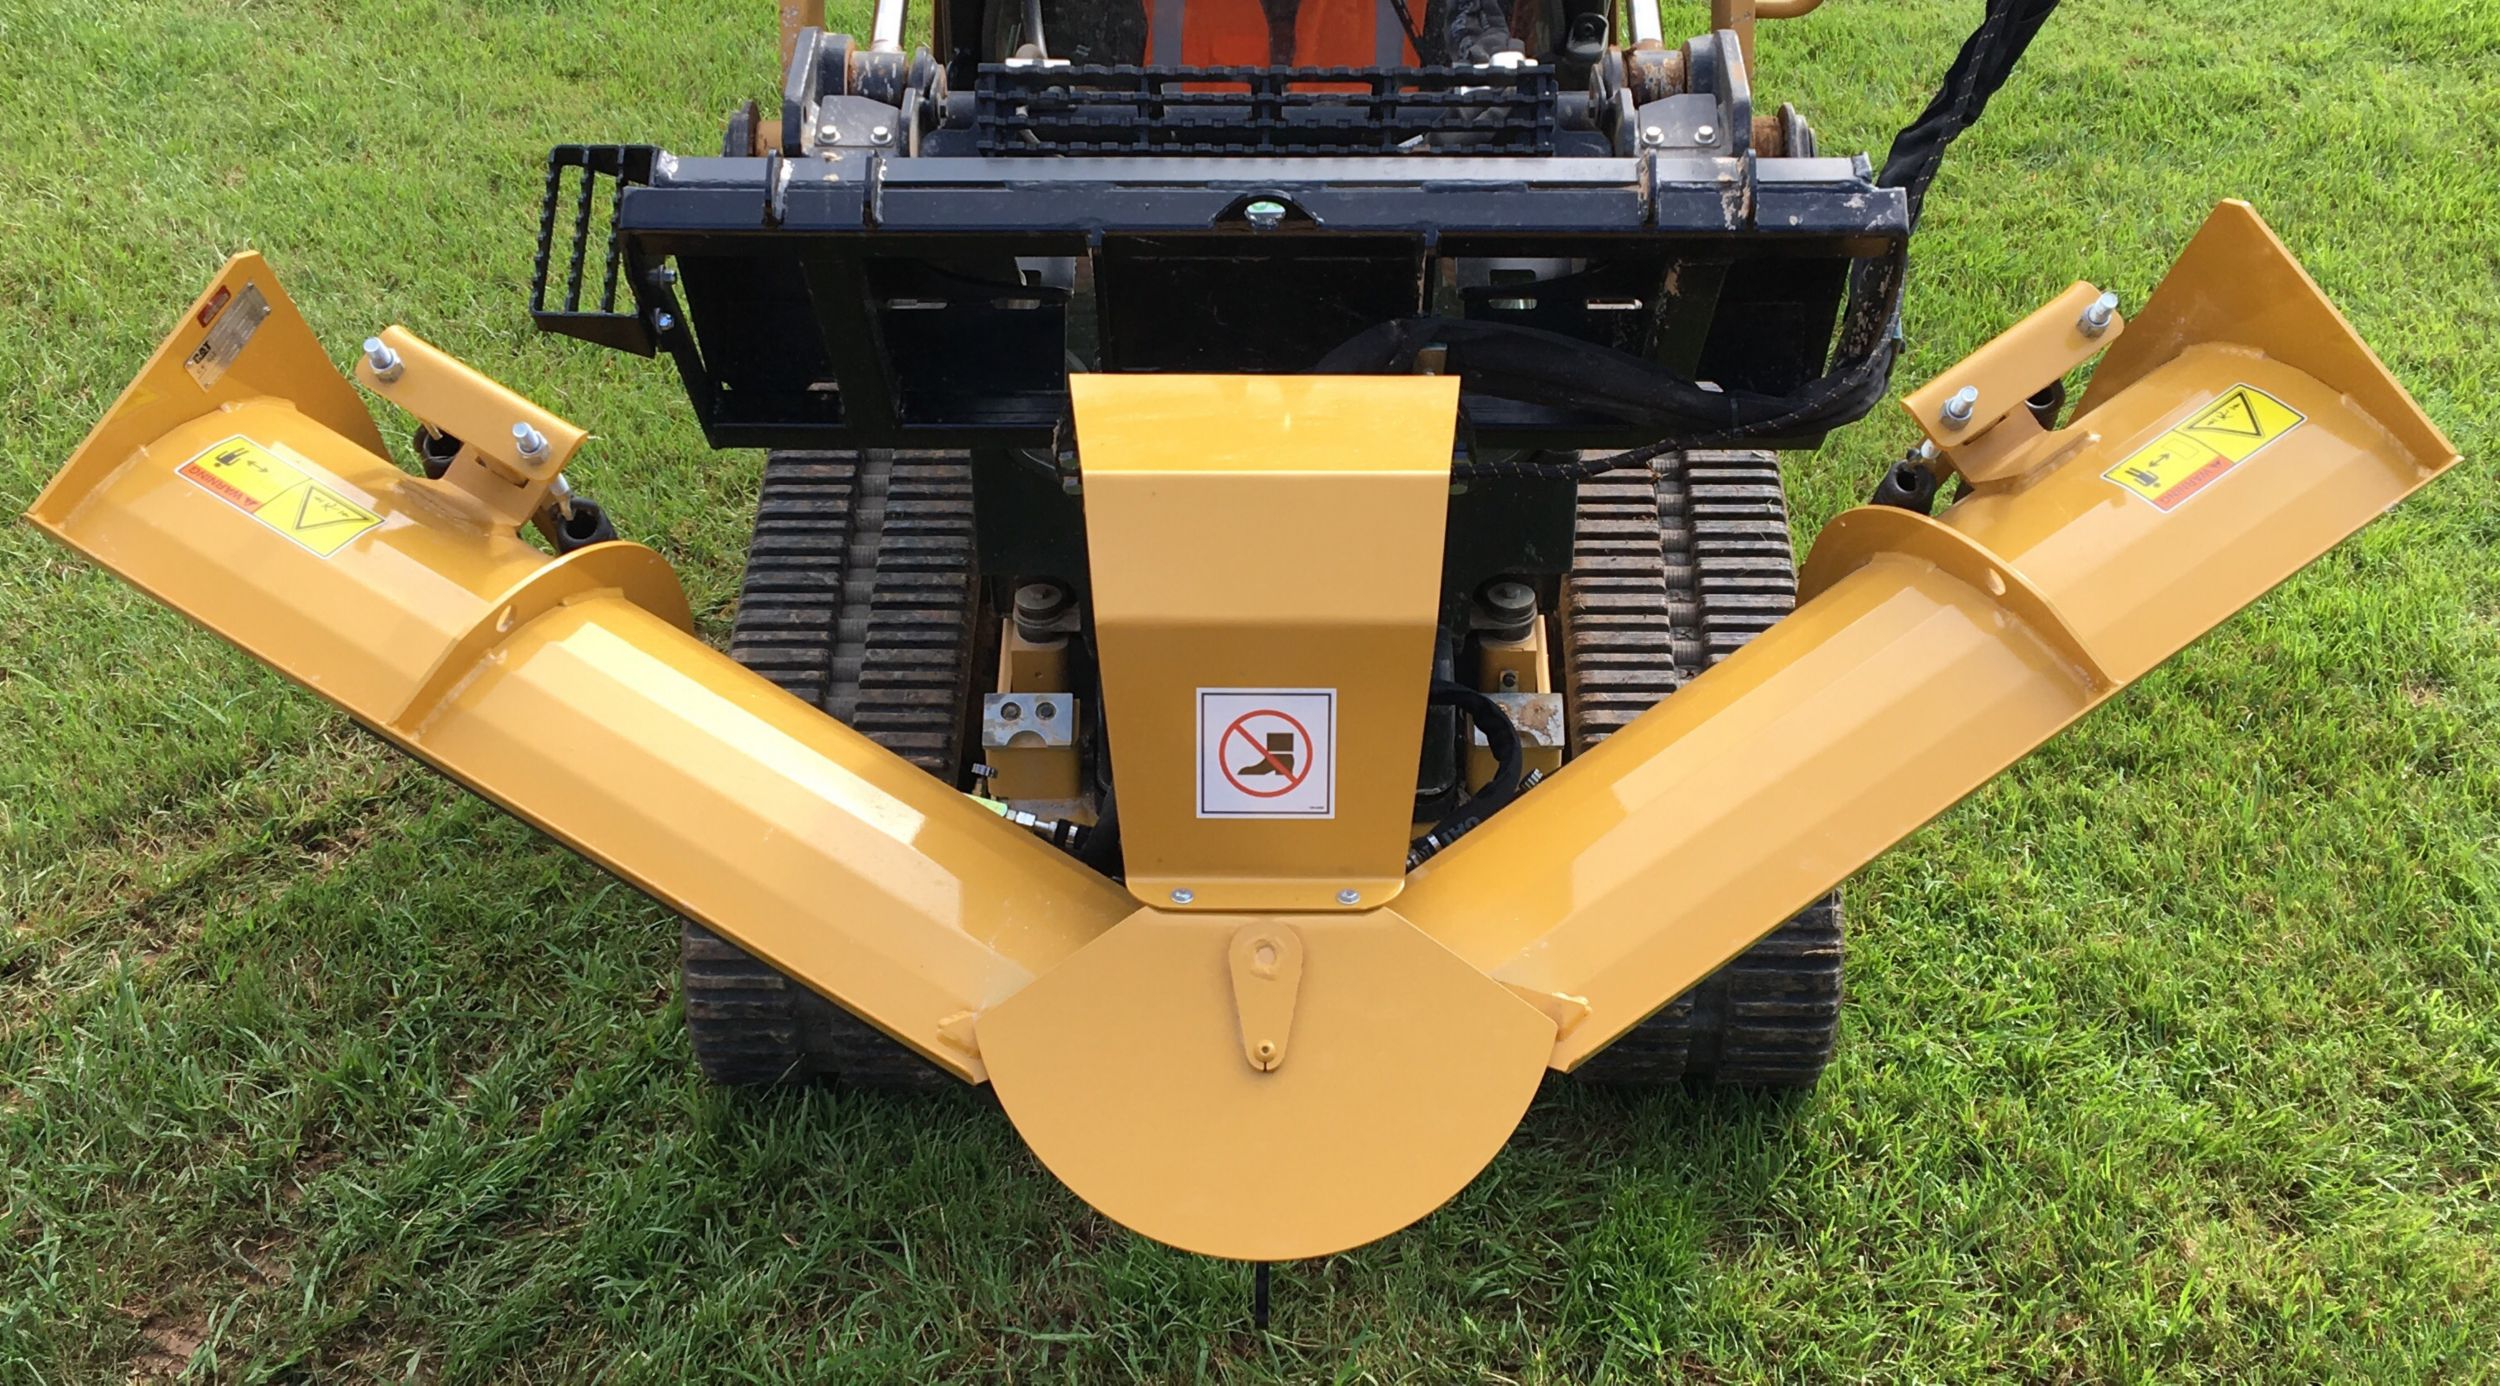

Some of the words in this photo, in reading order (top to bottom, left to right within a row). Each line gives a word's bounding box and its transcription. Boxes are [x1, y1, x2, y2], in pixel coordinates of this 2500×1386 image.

[192, 340, 212, 364] CAT
[187, 465, 242, 501] WARNING
[2160, 467, 2213, 503] WARNING
